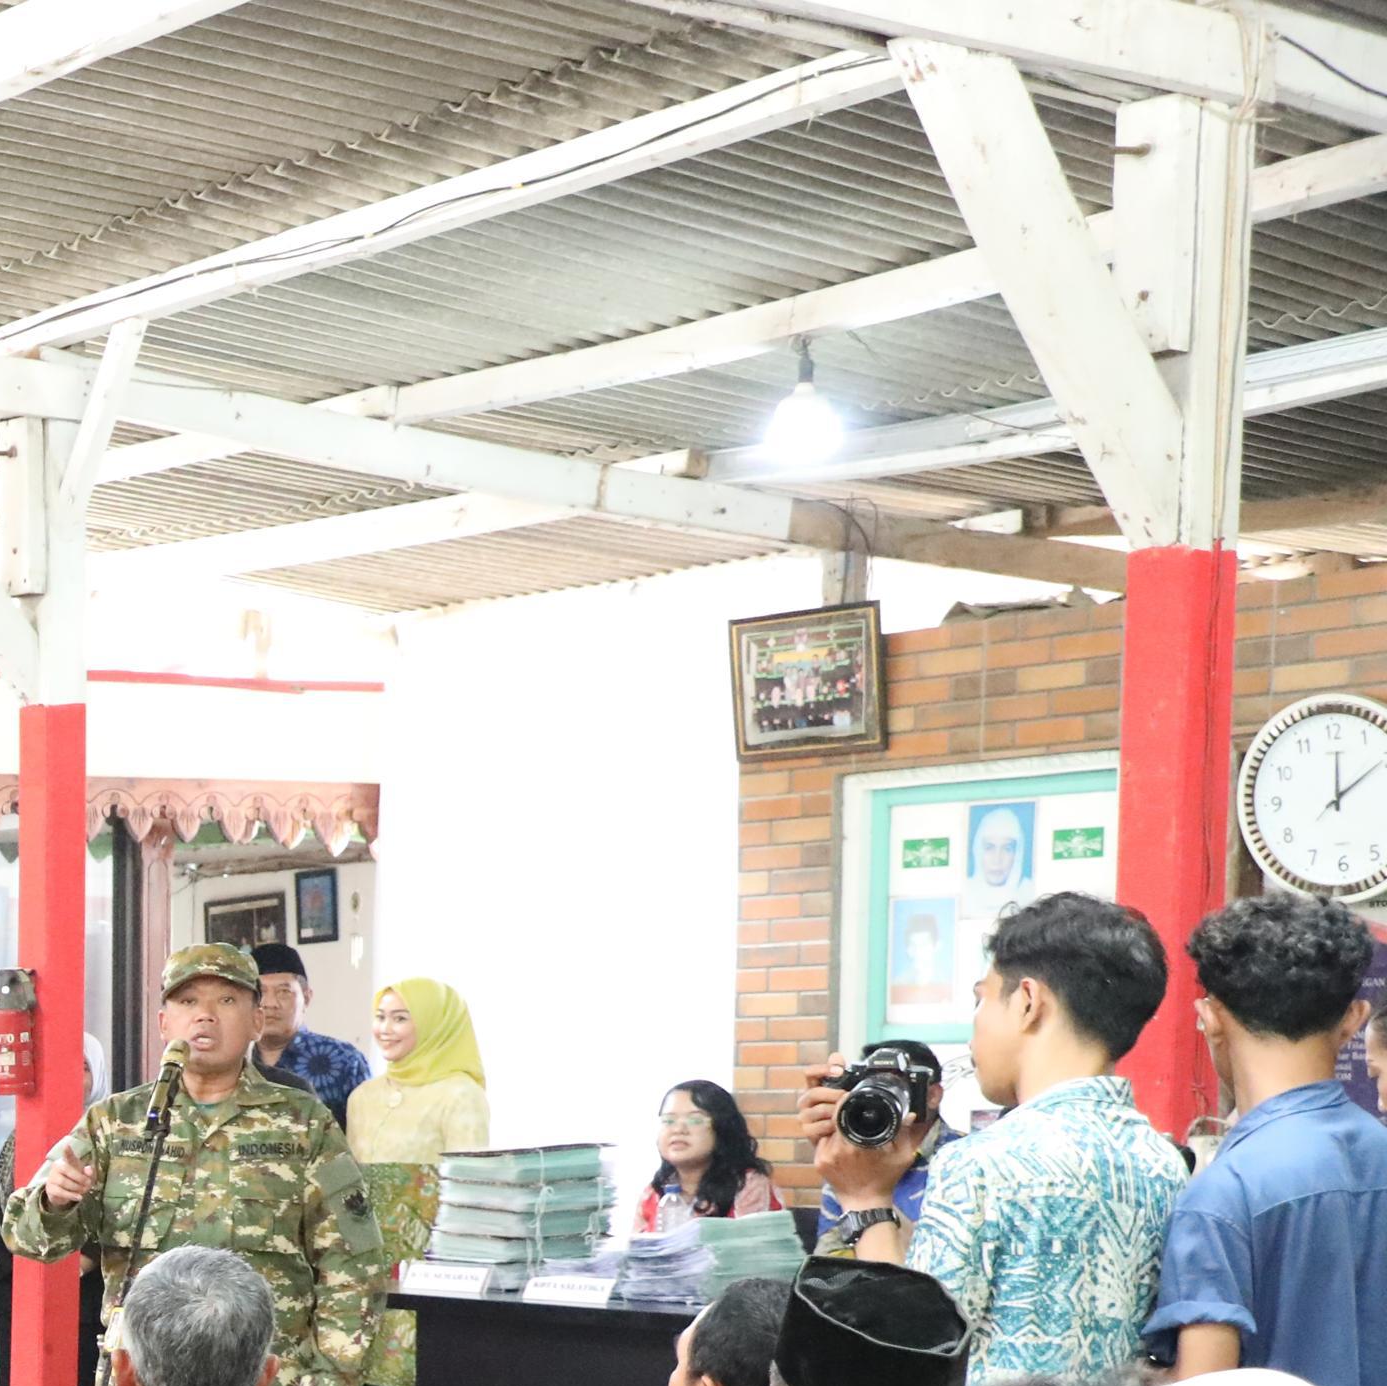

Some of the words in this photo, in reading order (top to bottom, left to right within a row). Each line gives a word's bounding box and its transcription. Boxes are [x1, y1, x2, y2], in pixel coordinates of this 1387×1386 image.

[1325, 723, 1341, 740] 12
[1296, 738, 1311, 755] 11
[1277, 765, 1293, 782] 10
[1270, 796, 1283, 813] 9
[1283, 827, 1294, 843] 8
[1307, 849, 1318, 866] 7
[1369, 844, 1380, 861] 5
[1337, 855, 1349, 872] 6
[237, 1142, 304, 1156] INDONESIA
